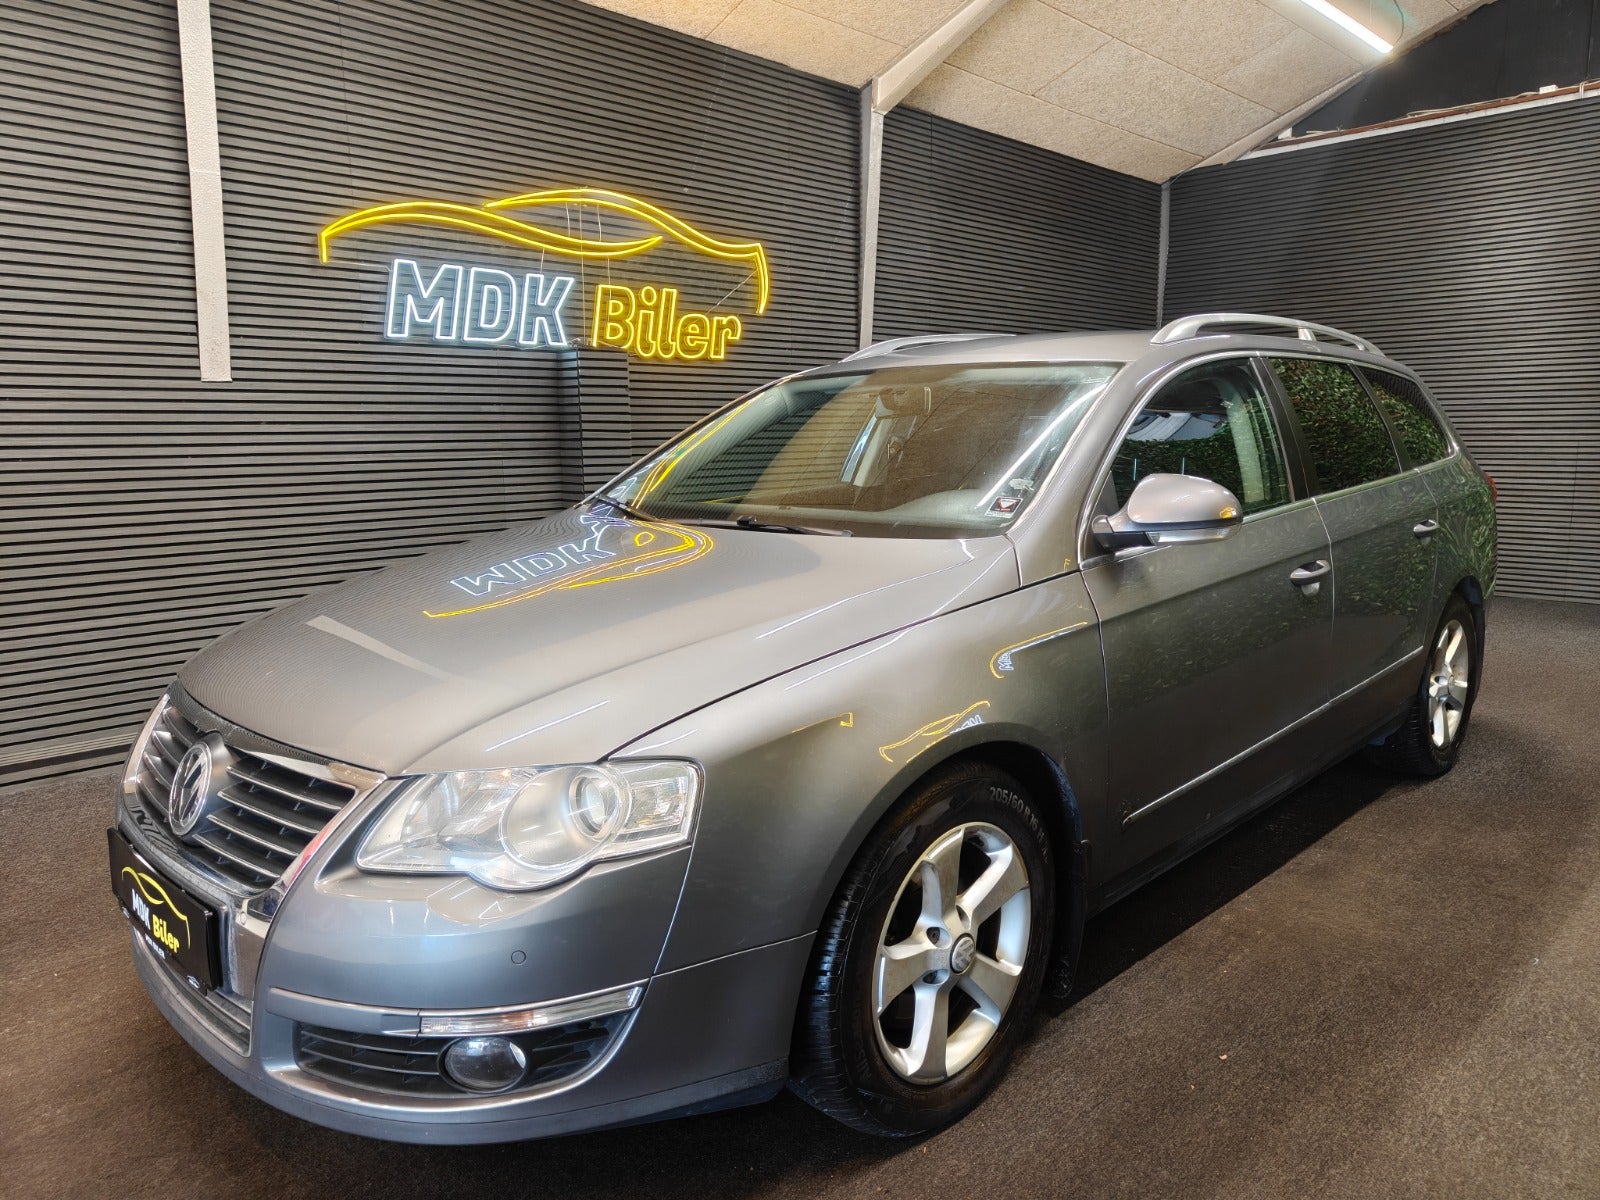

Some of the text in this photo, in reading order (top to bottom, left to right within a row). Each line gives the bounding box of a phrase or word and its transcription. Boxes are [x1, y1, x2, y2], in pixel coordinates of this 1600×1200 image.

[387, 258, 743, 361] MDK Biler
[989, 786, 1024, 813] 205/60
[131, 888, 150, 930] MDK
[152, 914, 180, 953] Biler
